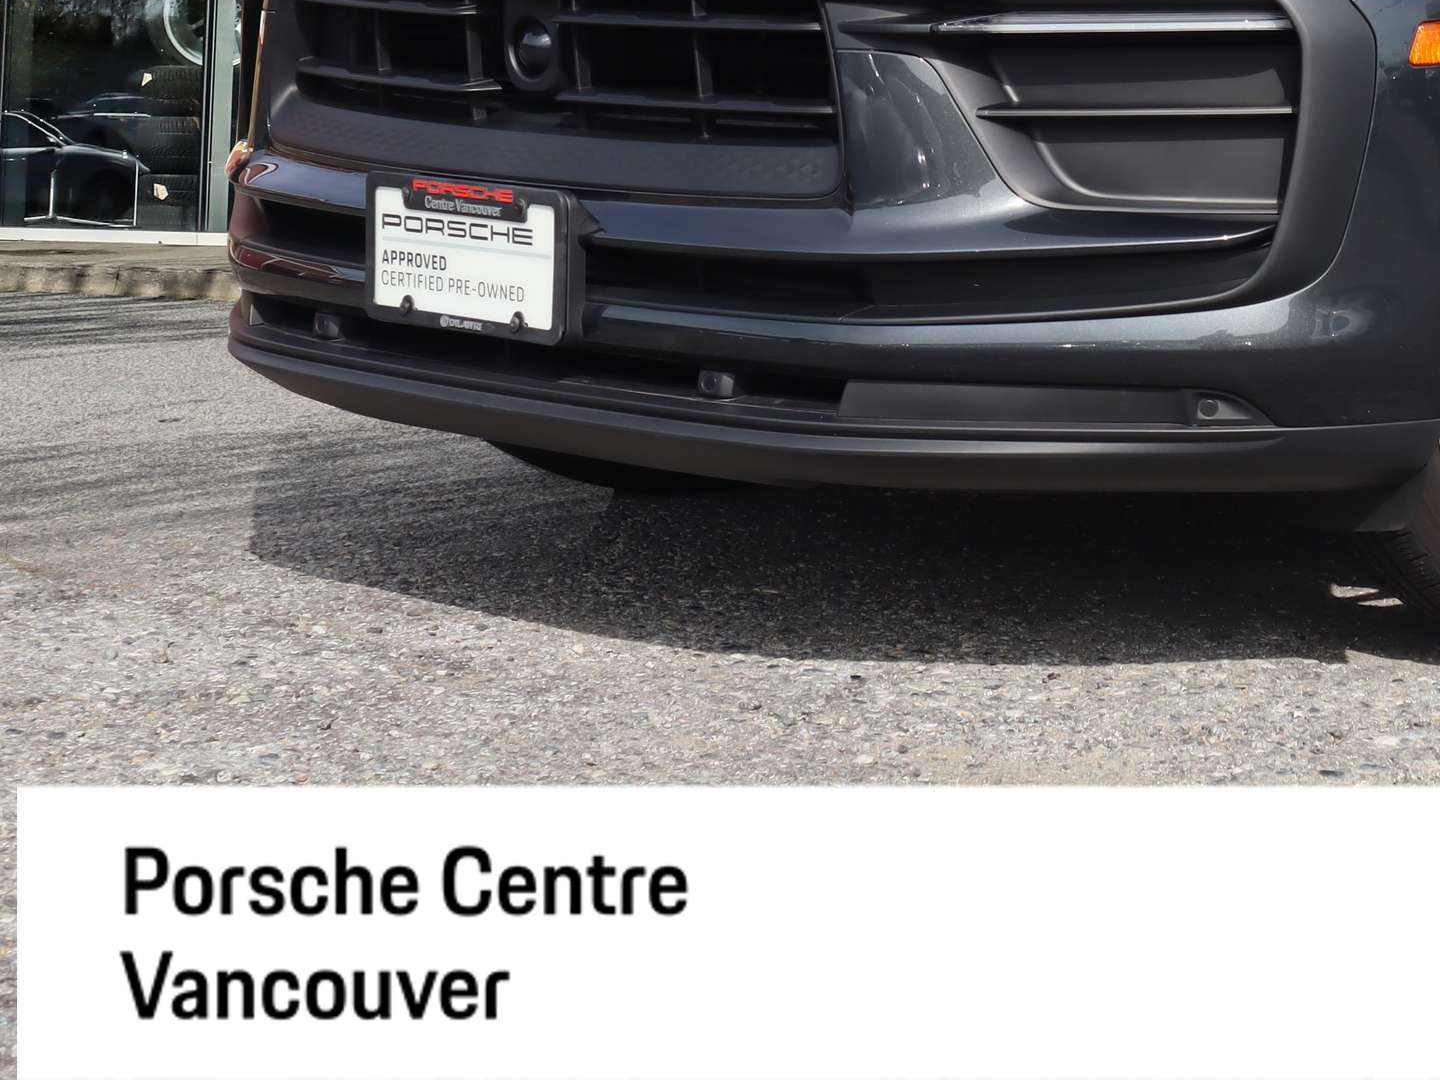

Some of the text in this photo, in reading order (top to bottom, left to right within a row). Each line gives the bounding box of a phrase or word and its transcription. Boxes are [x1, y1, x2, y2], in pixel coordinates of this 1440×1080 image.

[411, 178, 513, 203] PORSCHE
[424, 195, 503, 217] Centre Vancouver
[382, 213, 533, 245] PORSCHE
[381, 250, 447, 271] APPROVED
[381, 270, 525, 302] CERTIFIED PRE-OWNED
